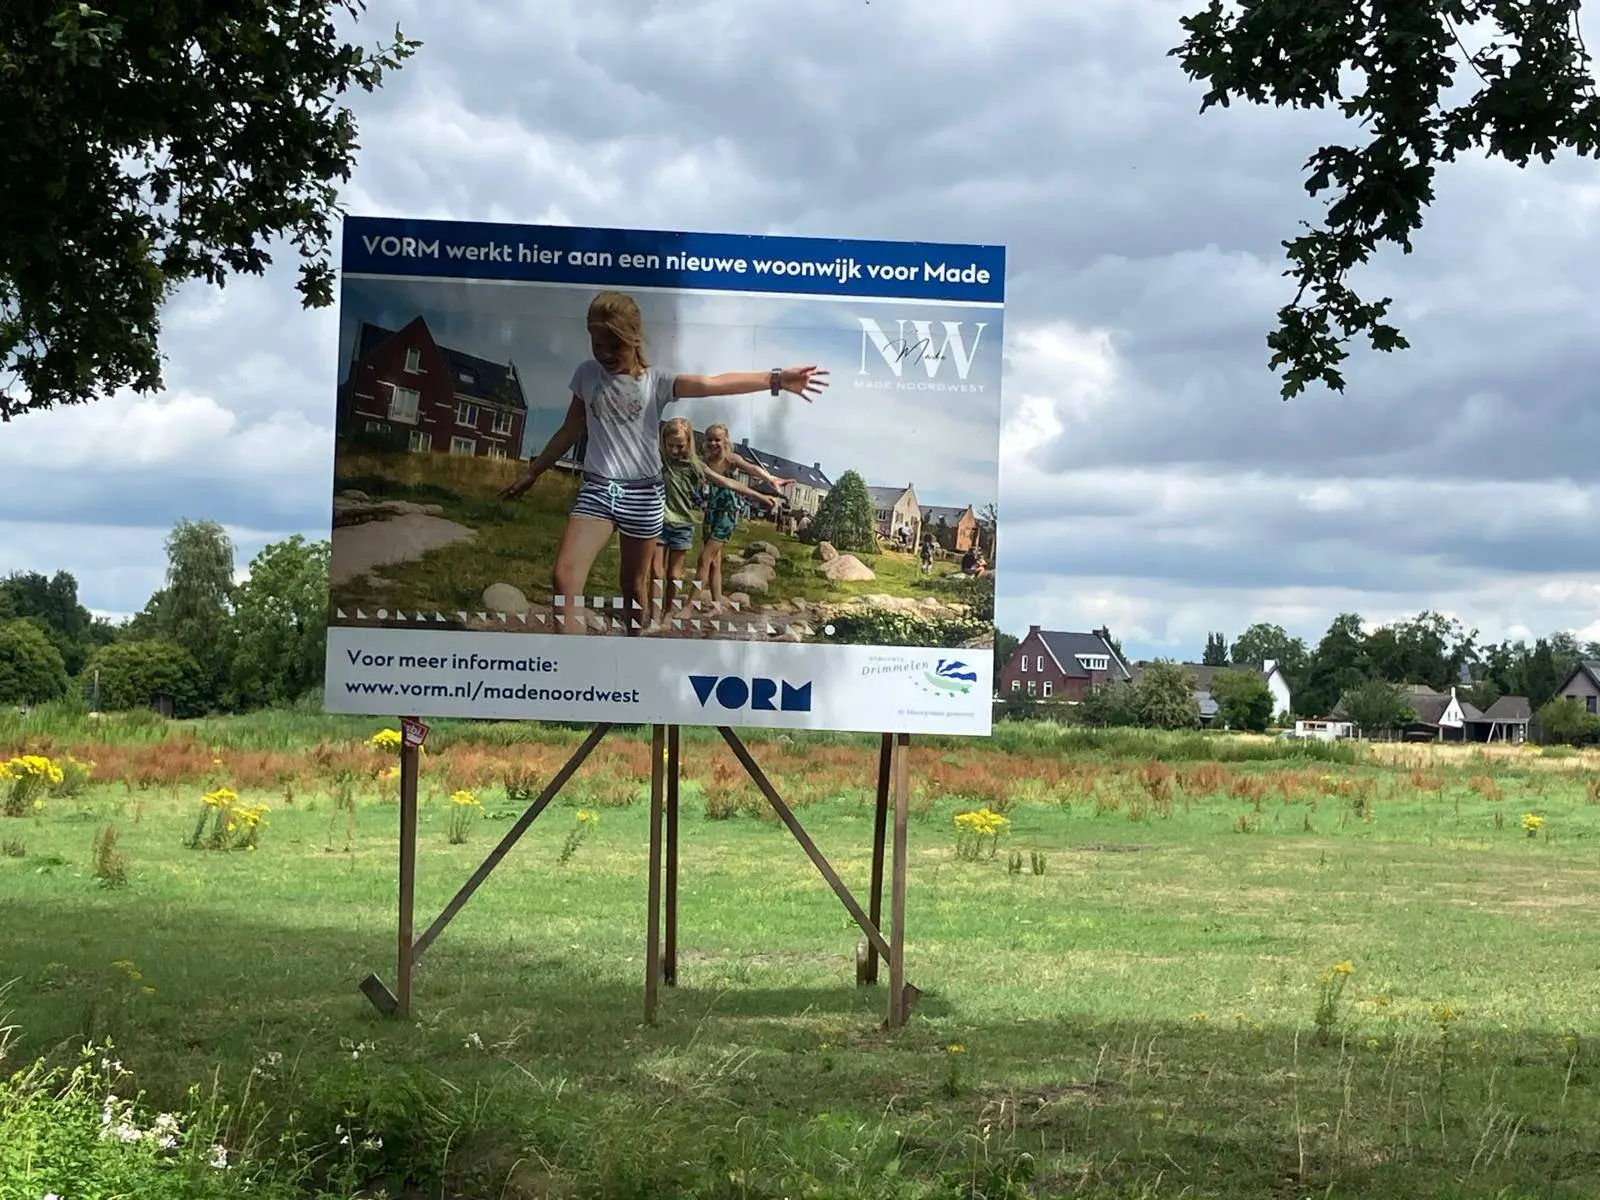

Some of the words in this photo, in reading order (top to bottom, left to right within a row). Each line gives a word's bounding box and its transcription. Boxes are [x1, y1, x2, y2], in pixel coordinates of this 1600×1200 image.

[362, 235, 440, 258] VORM
[446, 242, 512, 263] werkt
[518, 243, 562, 265] hier
[568, 250, 612, 267] aan
[619, 254, 659, 269] een
[666, 252, 747, 273] nieuwe
[753, 258, 862, 284] woonwijk
[867, 263, 919, 281] voor
[924, 262, 990, 284] Made
[857, 318, 988, 379] NW
[854, 380, 892, 390] MADE
[897, 381, 986, 393] NOORDWEST
[347, 649, 395, 667] Voor
[399, 655, 447, 669] meer
[452, 653, 558, 672] informatie:
[862, 660, 929, 676] Drimmelen
[346, 681, 640, 703] www.vorm.nl/madenoordwest
[688, 675, 812, 712] VORM
